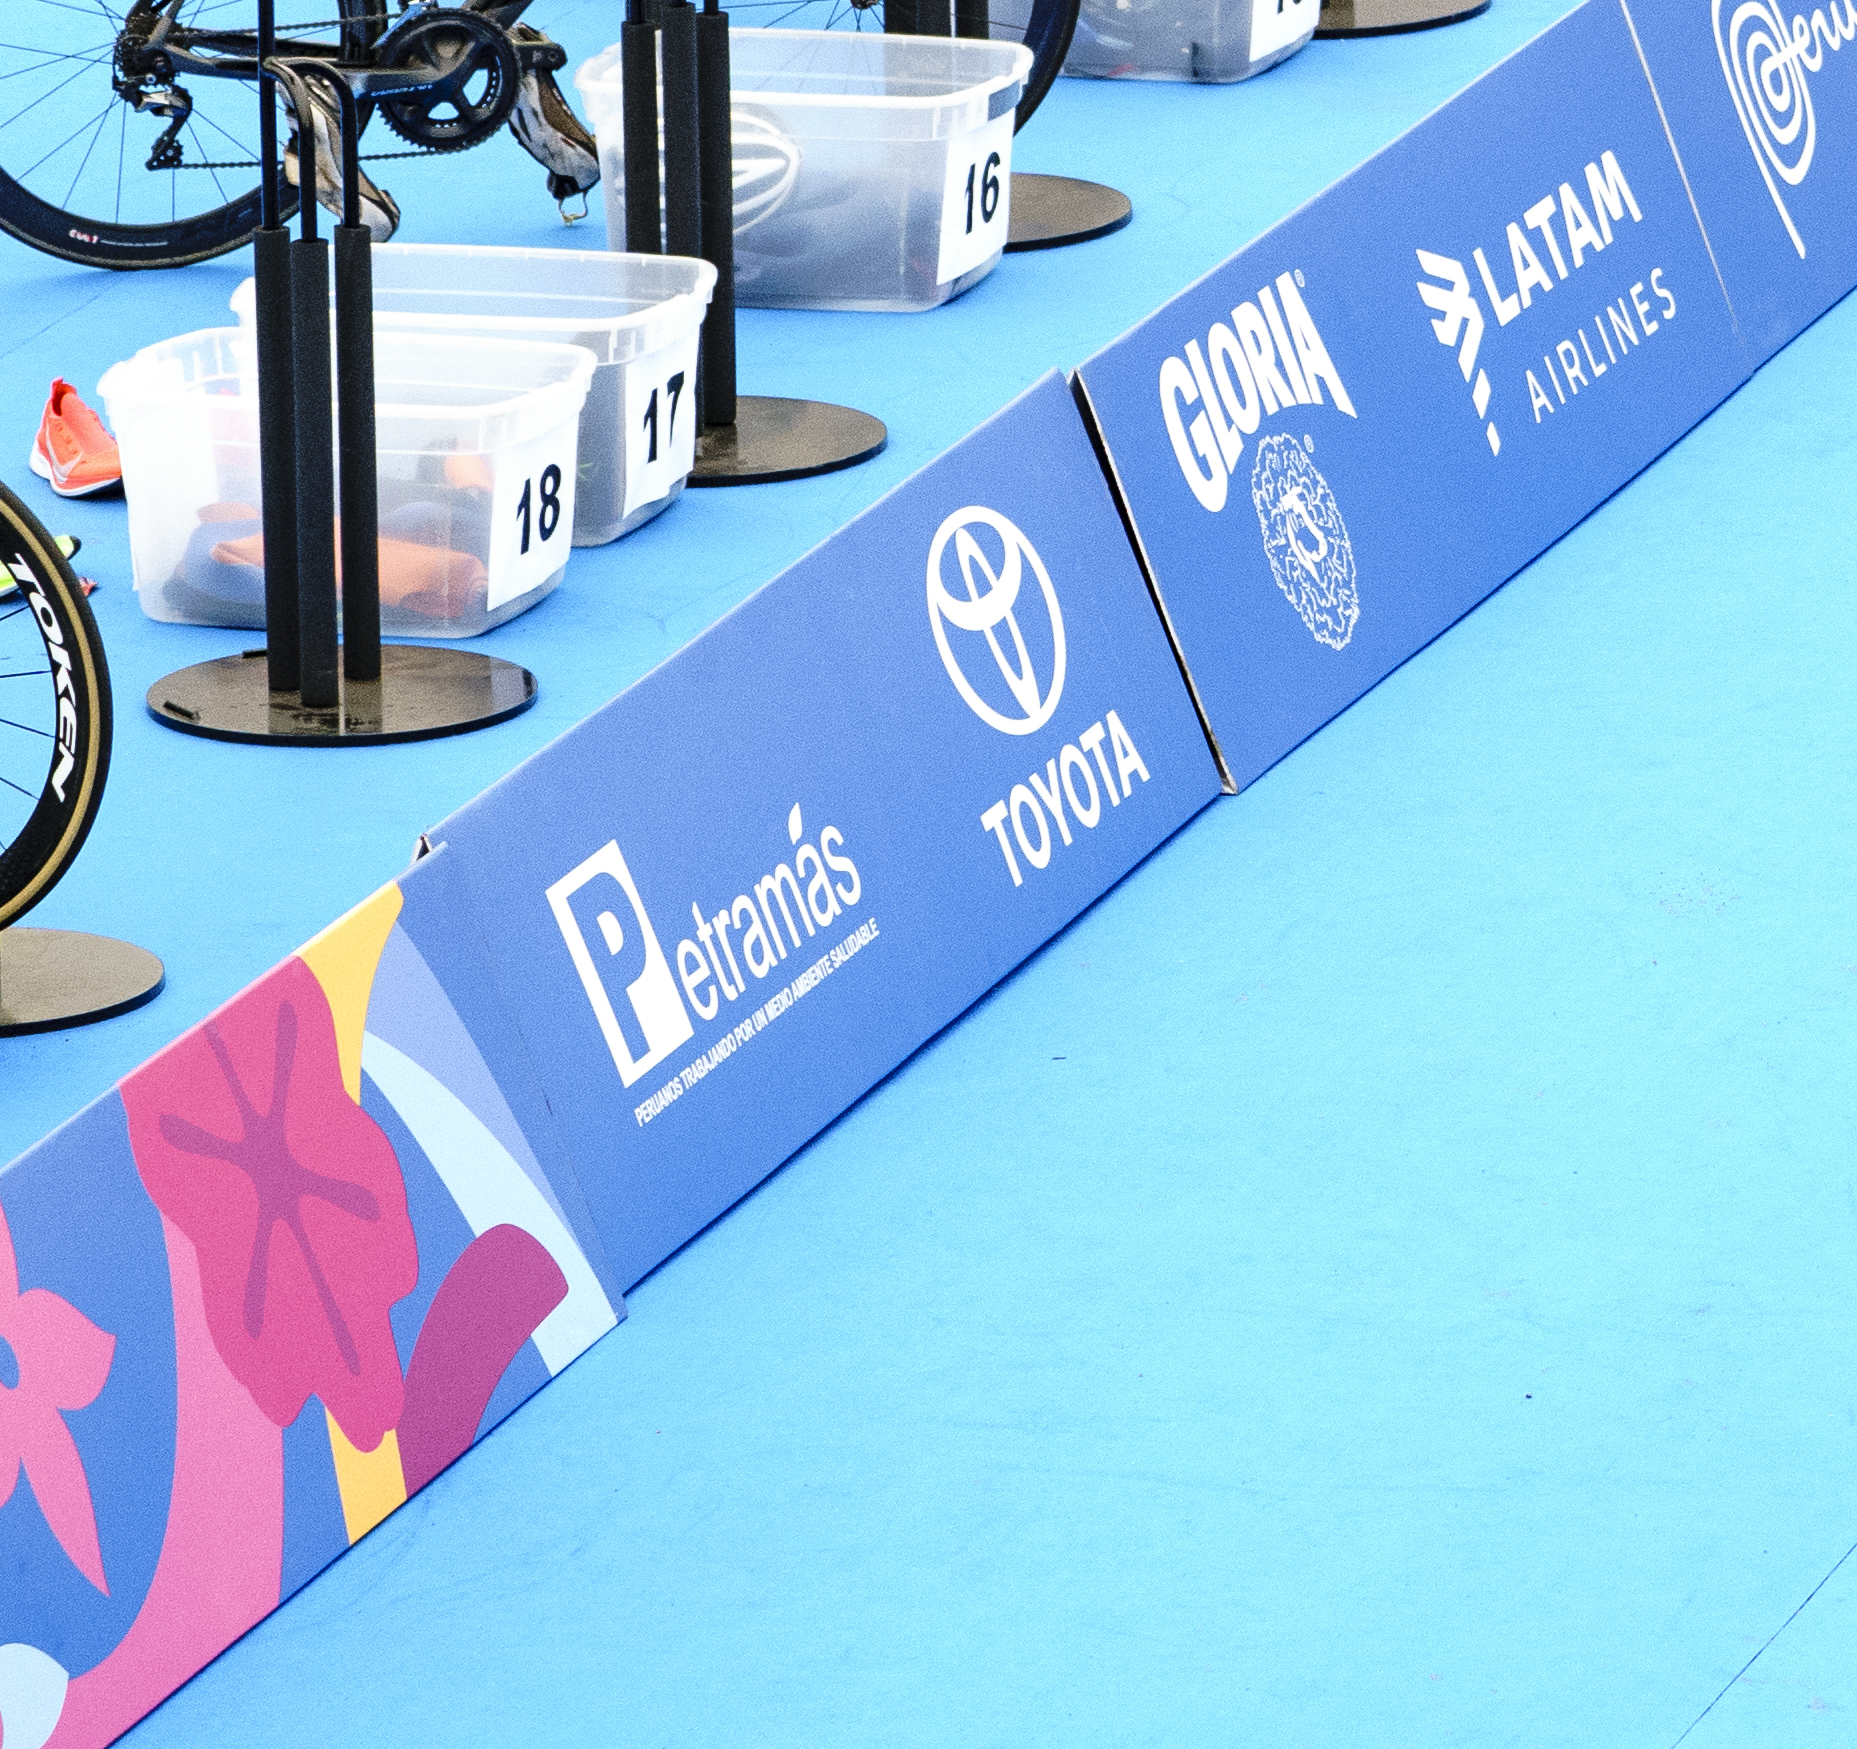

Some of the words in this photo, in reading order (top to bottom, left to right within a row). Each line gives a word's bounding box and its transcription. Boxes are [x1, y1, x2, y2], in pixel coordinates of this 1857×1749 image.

[964, 150, 1001, 235] 16
[1472, 150, 1643, 326] LATAM
[643, 370, 685, 465] 17
[1159, 271, 1358, 513] GLORIA
[1525, 267, 1677, 424] AIRLINES
[516, 463, 562, 556] 18
[6, 552, 78, 803] TOKEN
[980, 710, 1150, 887] TOYOTA
[545, 802, 861, 1089] Petramás
[633, 1077, 684, 1127] PERUANOS
[680, 1033, 737, 1089] TRABAJANDO
[734, 1018, 756, 1046] POR
[752, 1007, 769, 1032] UN
[764, 987, 793, 1021] MEDIO
[791, 954, 834, 1002] AMBIENTE
[829, 917, 880, 968] SALUDABLE
